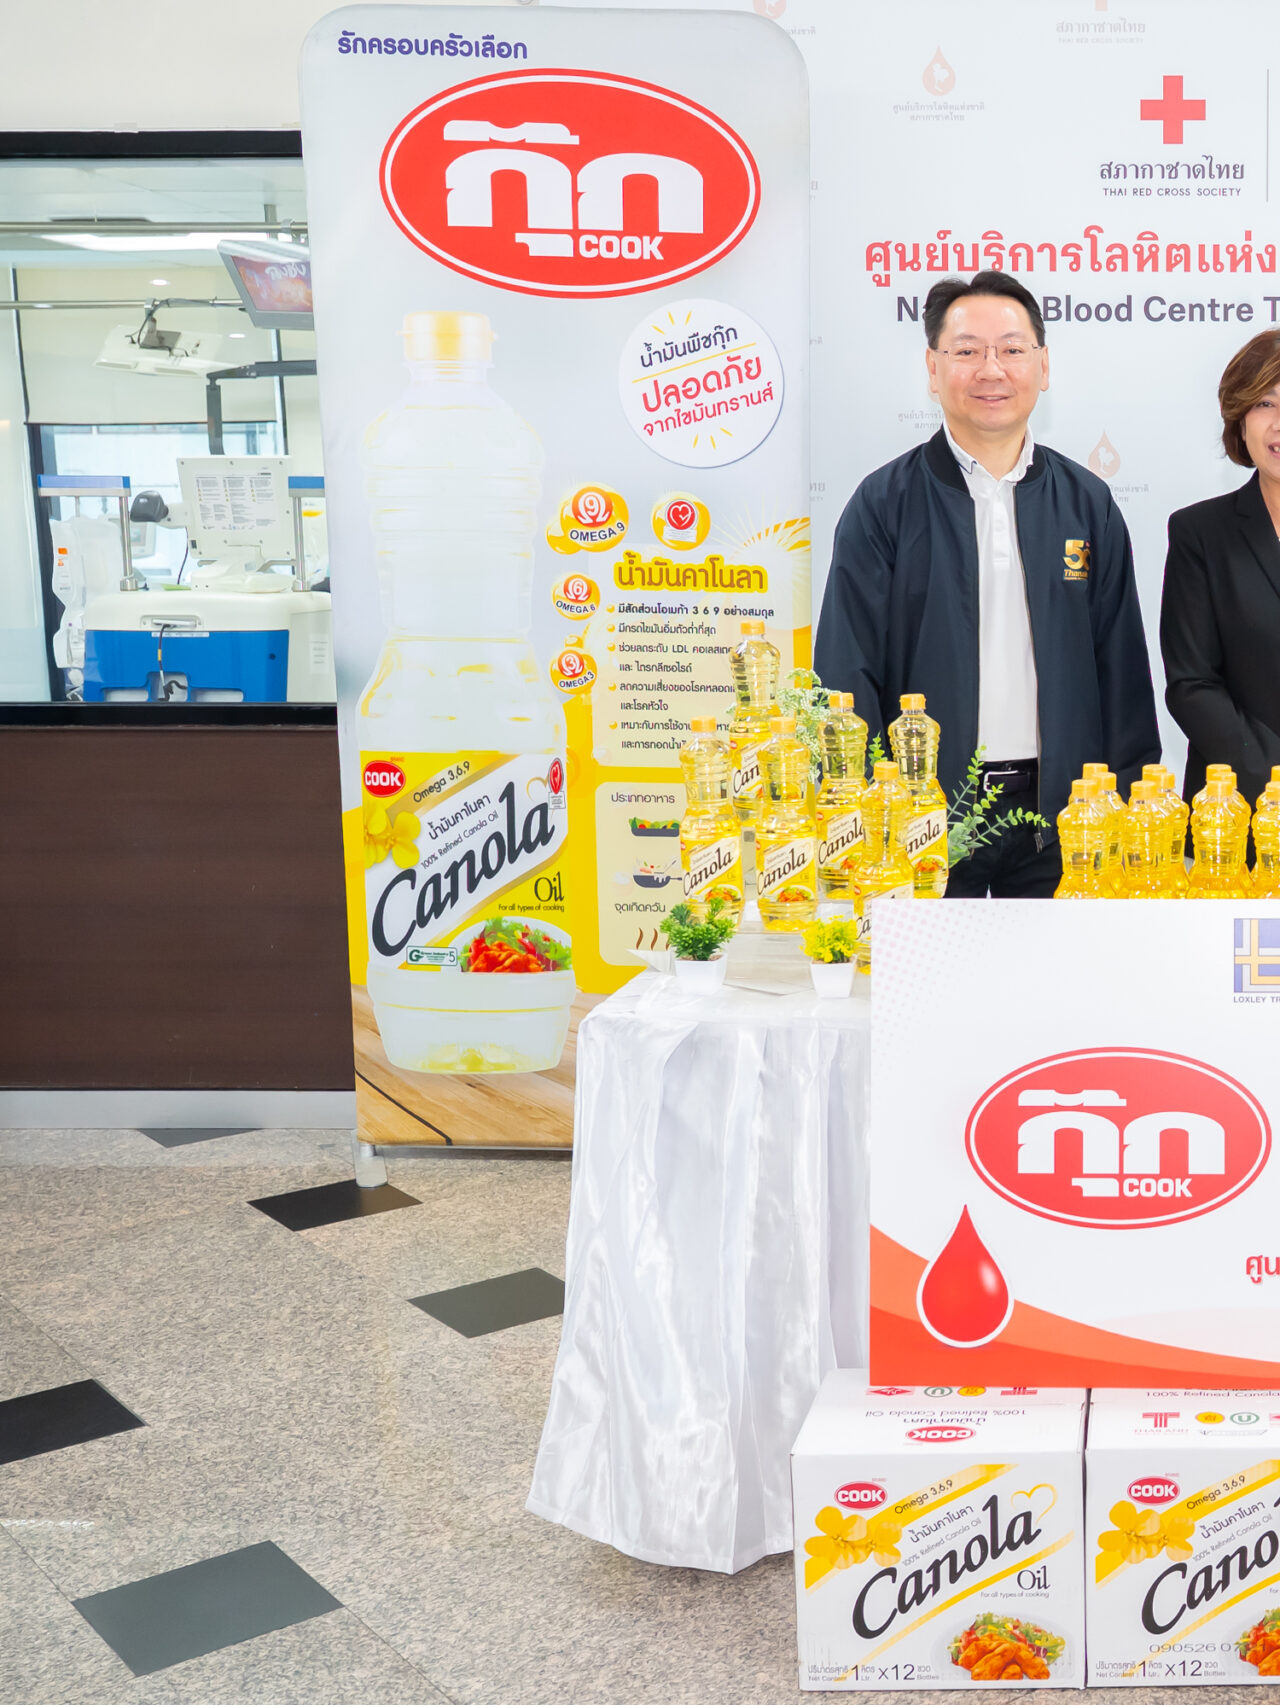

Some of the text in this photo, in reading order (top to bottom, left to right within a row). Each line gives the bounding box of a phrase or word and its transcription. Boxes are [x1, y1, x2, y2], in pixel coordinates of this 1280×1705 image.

[337, 30, 528, 59] รักครอบครัวเลือก
[1099, 155, 1245, 181] สภากาชาดไทย
[443, 120, 703, 257] กุ๊ก
[1103, 187, 1241, 197] THAI RED CROSS SOCIETY
[579, 236, 664, 260] COOK
[1042, 295, 1132, 322] Blood
[1143, 295, 1254, 322] Centre
[640, 323, 738, 369] น้ำมันพืชกุ๊ก
[642, 354, 763, 412] ปลอดภัย
[643, 382, 774, 437] จากไขมันทรานส์
[569, 522, 625, 542] OMEGA 9
[618, 553, 763, 590] น้ำมันคาโนลา
[556, 600, 596, 613] OMEGA 6
[618, 603, 689, 614] มีสัดส่วนโอเมก้า
[714, 607, 720, 615] 9
[724, 604, 774, 617] อย่างสมดุล
[619, 642, 668, 653] ช่วยลดระดับ
[672, 645, 689, 653] LDL
[620, 662, 633, 671] และ
[559, 671, 595, 689] OMEGA 3
[620, 679, 735, 692] ลดความเสี่ยงของโรคหลอดเ
[621, 699, 668, 710] และโรคหัวใจ
[364, 771, 403, 787] COOK
[413, 761, 471, 803] Omega 3,6,9
[611, 792, 675, 805] ประเภทอาหาร
[428, 794, 491, 841] น้ำมันคาโนลา
[421, 810, 499, 870] 100% Refined Canola Oil
[372, 782, 556, 957] Canola
[683, 847, 733, 896] Canola
[757, 847, 807, 896] Canola
[534, 871, 565, 902] Oil
[517, 904, 534, 912] types
[543, 904, 565, 912] cooking
[615, 902, 666, 915] จุดเกิดควัน
[1018, 1090, 1225, 1198] กุ๊ก
[1123, 1178, 1192, 1198] COOK
[838, 1490, 883, 1502] COOK
[895, 1479, 953, 1515] Omega 3,6,9
[1131, 1485, 1175, 1497] COOK
[1187, 1475, 1246, 1510] Omega 3,6,9
[909, 1505, 974, 1544] น้ำมันคาโนลา
[1201, 1500, 1266, 1540] น้ำมันคาโนลา
[852, 1494, 1041, 1639] Canola
[1016, 1566, 1050, 1590] Oil
[1149, 1643, 1216, 1653] 090526
[851, 1664, 859, 1680] 1
[1138, 1660, 1147, 1677] 1
